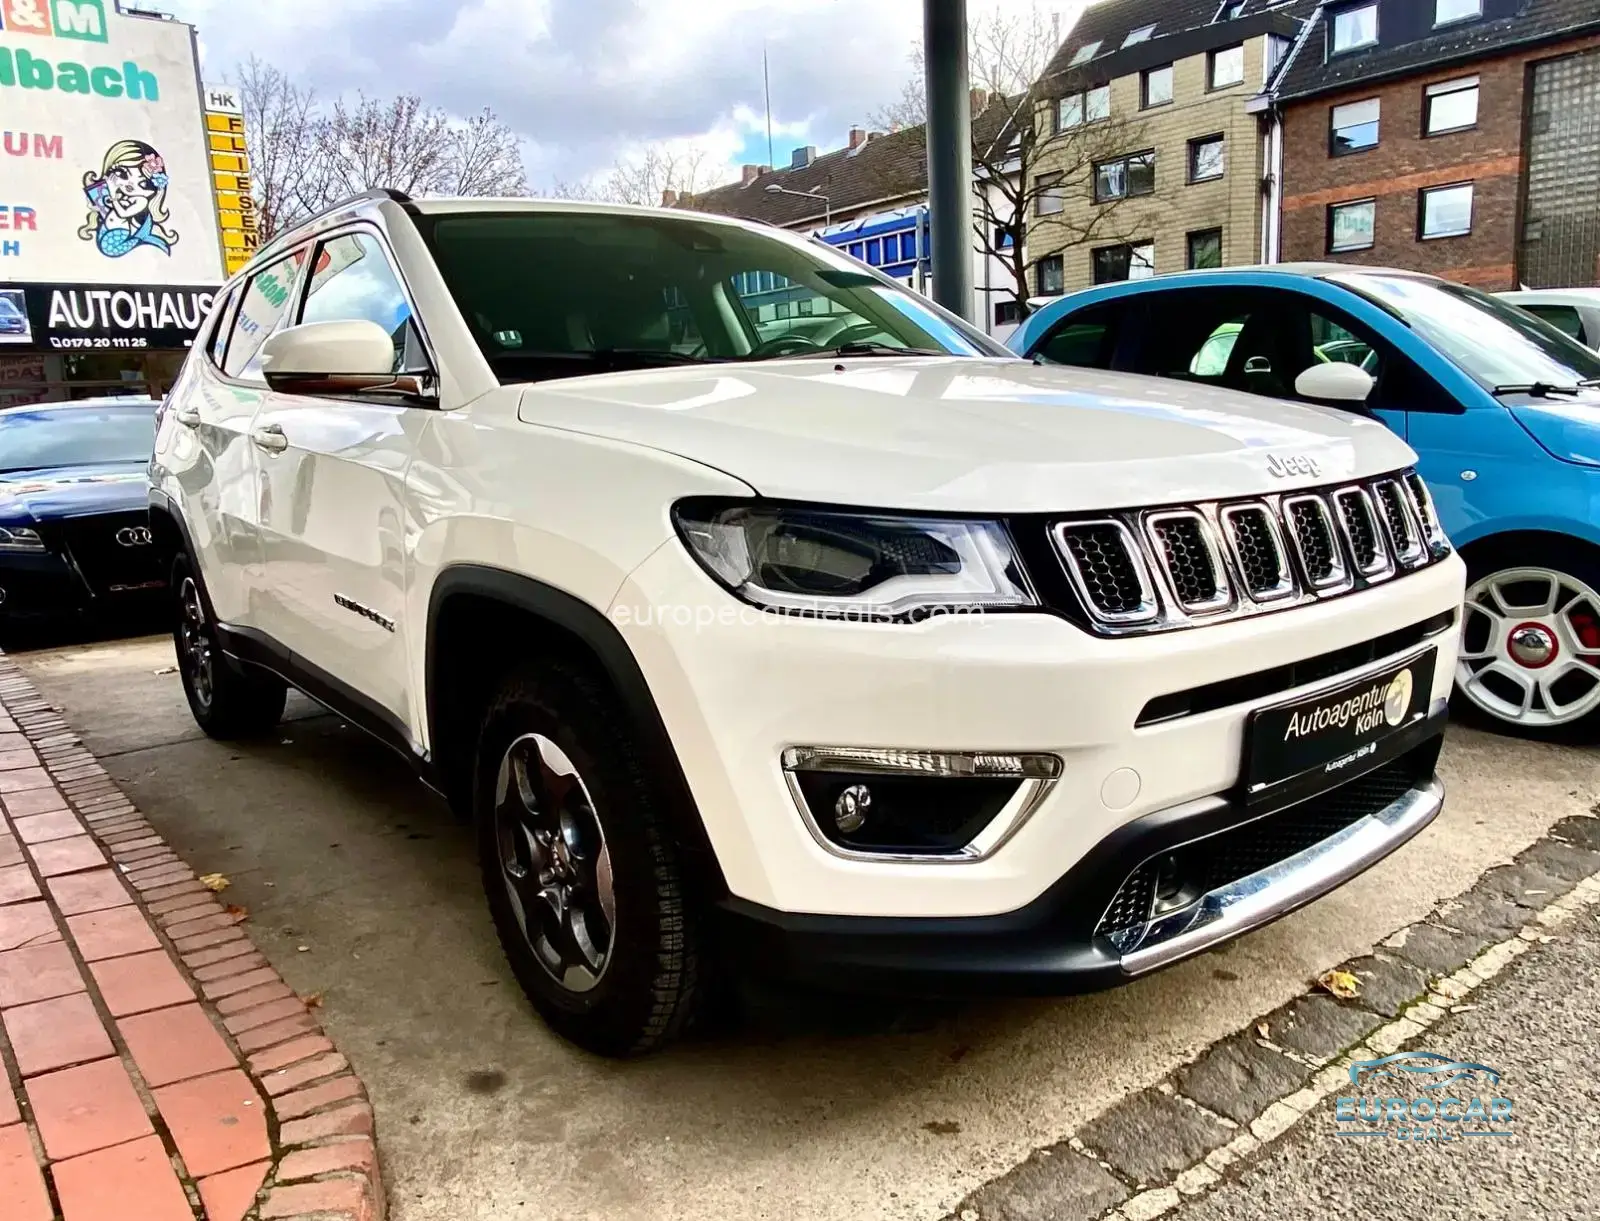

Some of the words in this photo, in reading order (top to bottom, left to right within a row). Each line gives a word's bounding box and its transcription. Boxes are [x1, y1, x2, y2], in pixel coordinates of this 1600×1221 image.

[210, 92, 236, 108] HK
[228, 117, 258, 248] FLIESEN
[48, 290, 214, 330] AUTOHAUS
[61, 337, 93, 348] 0178
[94, 338, 111, 348] 20
[112, 337, 131, 347] 111
[131, 337, 148, 347] 25
[1266, 453, 1322, 478] Jeep
[1284, 682, 1391, 741] Autoagentur
[1355, 708, 1384, 735] Köln
